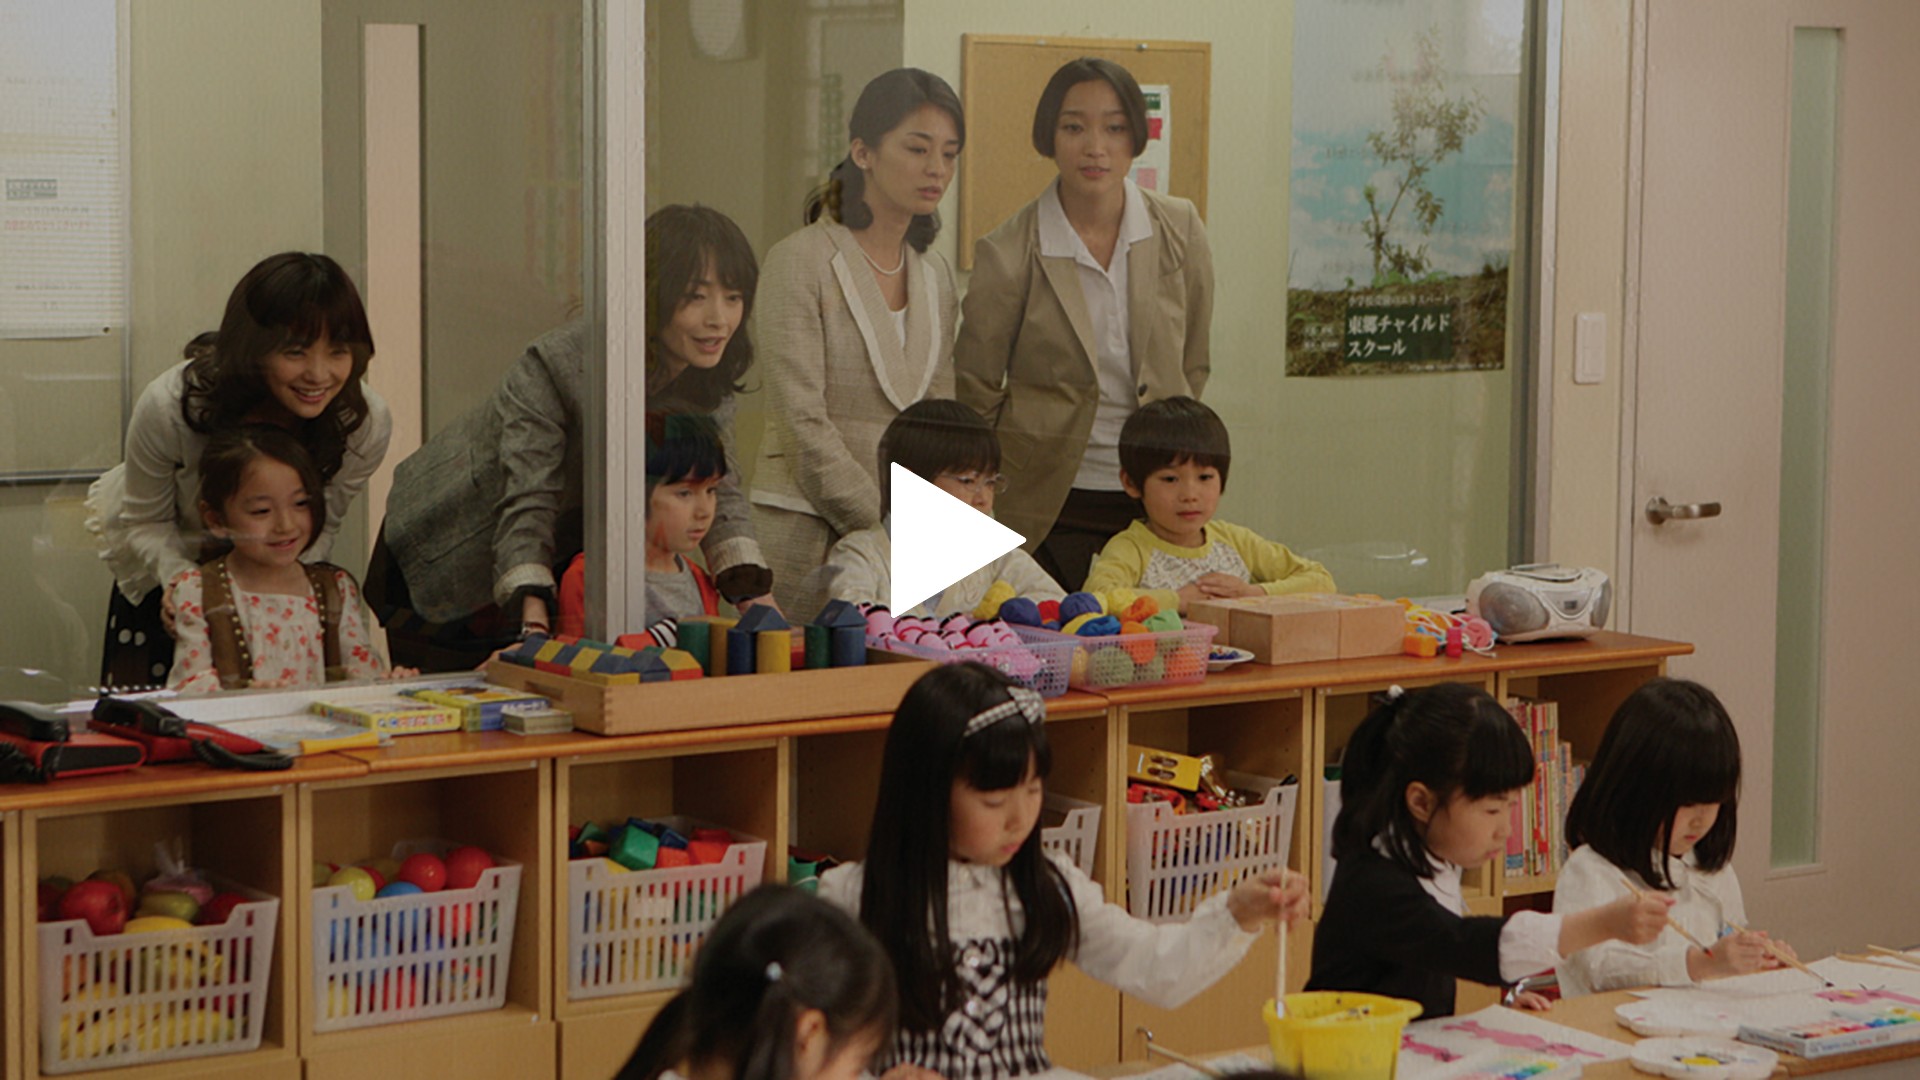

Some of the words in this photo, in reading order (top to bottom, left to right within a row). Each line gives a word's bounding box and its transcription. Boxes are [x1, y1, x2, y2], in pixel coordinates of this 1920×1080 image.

[1348, 313, 1450, 335] 東郷チャイルド
[1347, 338, 1407, 358] スクール
